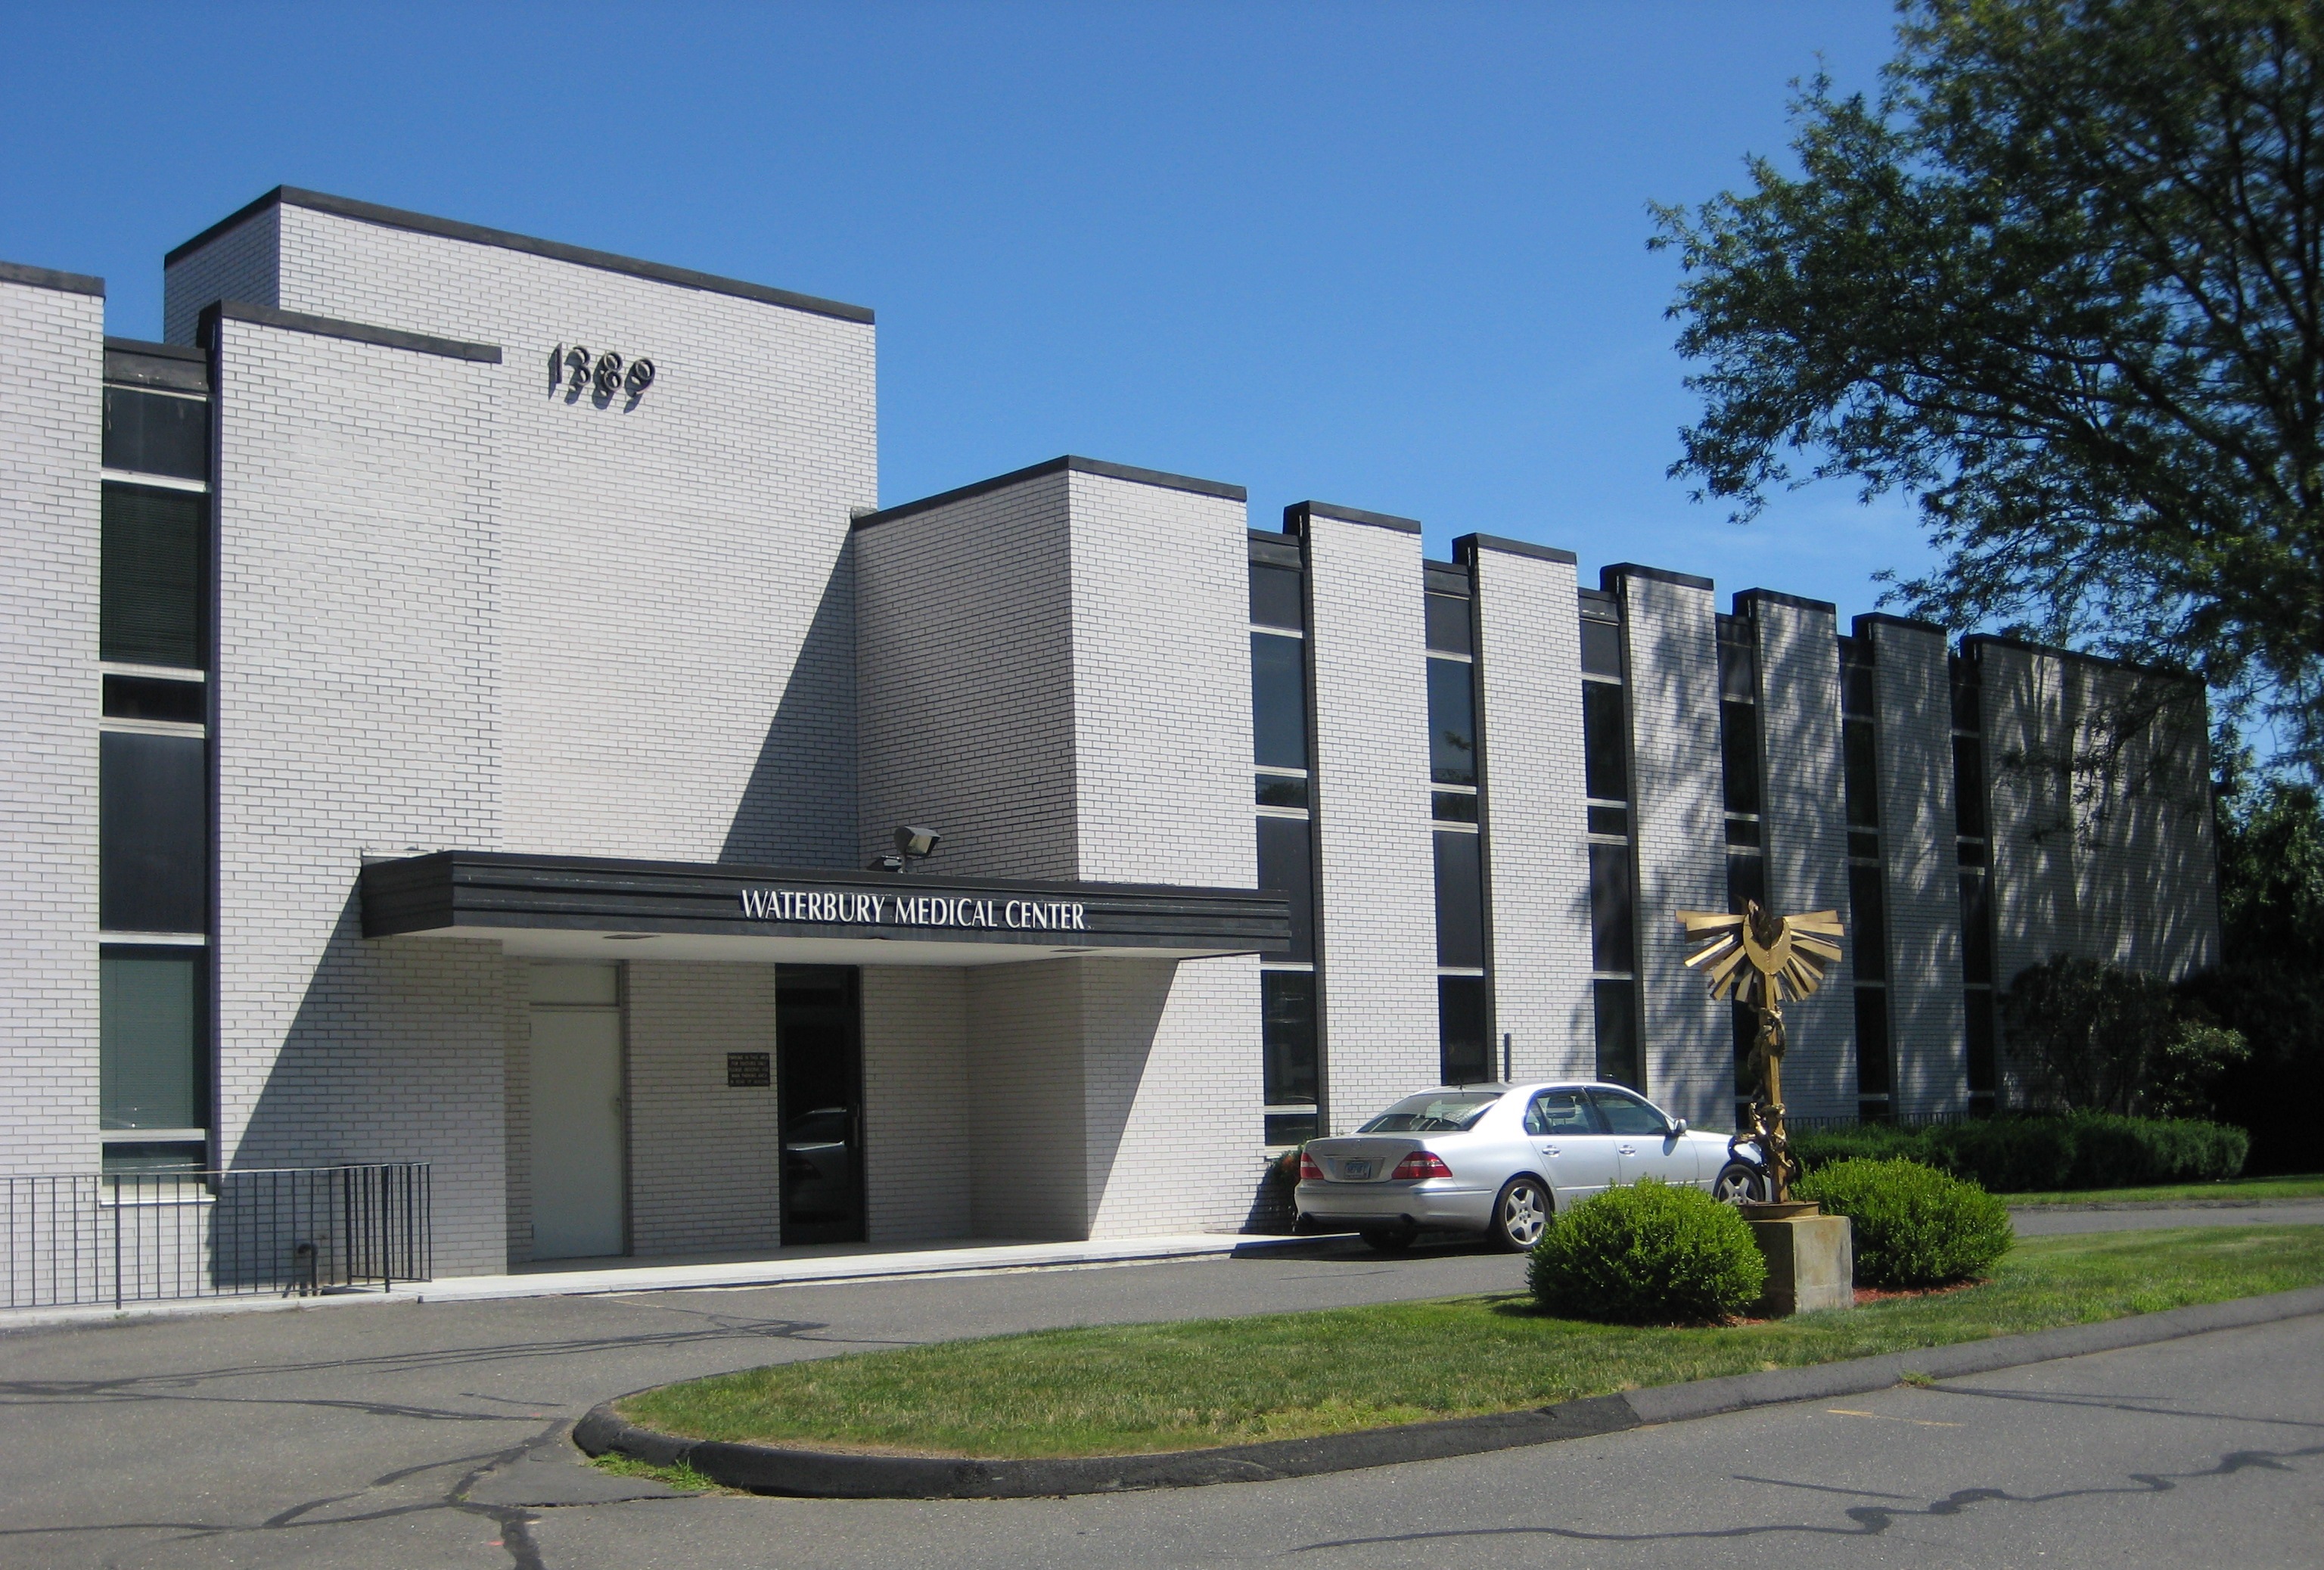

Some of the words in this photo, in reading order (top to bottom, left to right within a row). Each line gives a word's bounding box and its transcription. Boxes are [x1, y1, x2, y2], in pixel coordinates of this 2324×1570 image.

[550, 342, 656, 396] 1389
[741, 888, 886, 924] WATERBURY
[894, 895, 998, 928] MEDICAL
[1004, 899, 1085, 931] CENTER
